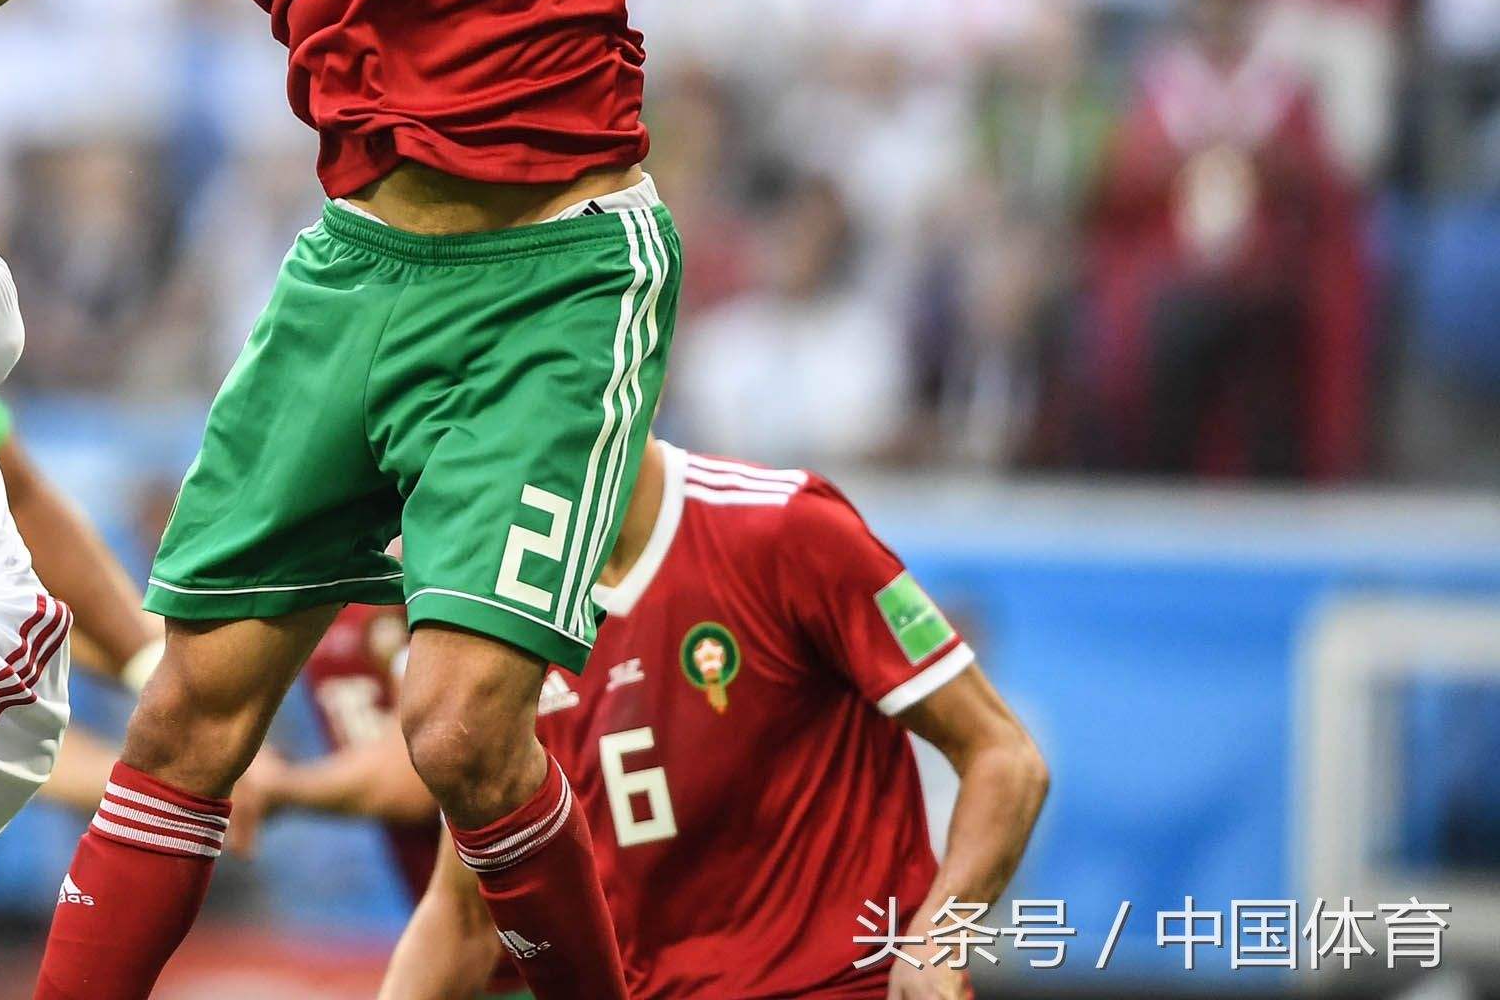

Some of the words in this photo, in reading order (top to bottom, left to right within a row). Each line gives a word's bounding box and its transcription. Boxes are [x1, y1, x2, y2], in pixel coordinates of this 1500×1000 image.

[494, 483, 573, 613] 2
[599, 725, 678, 848] 6
[57, 890, 96, 907] das
